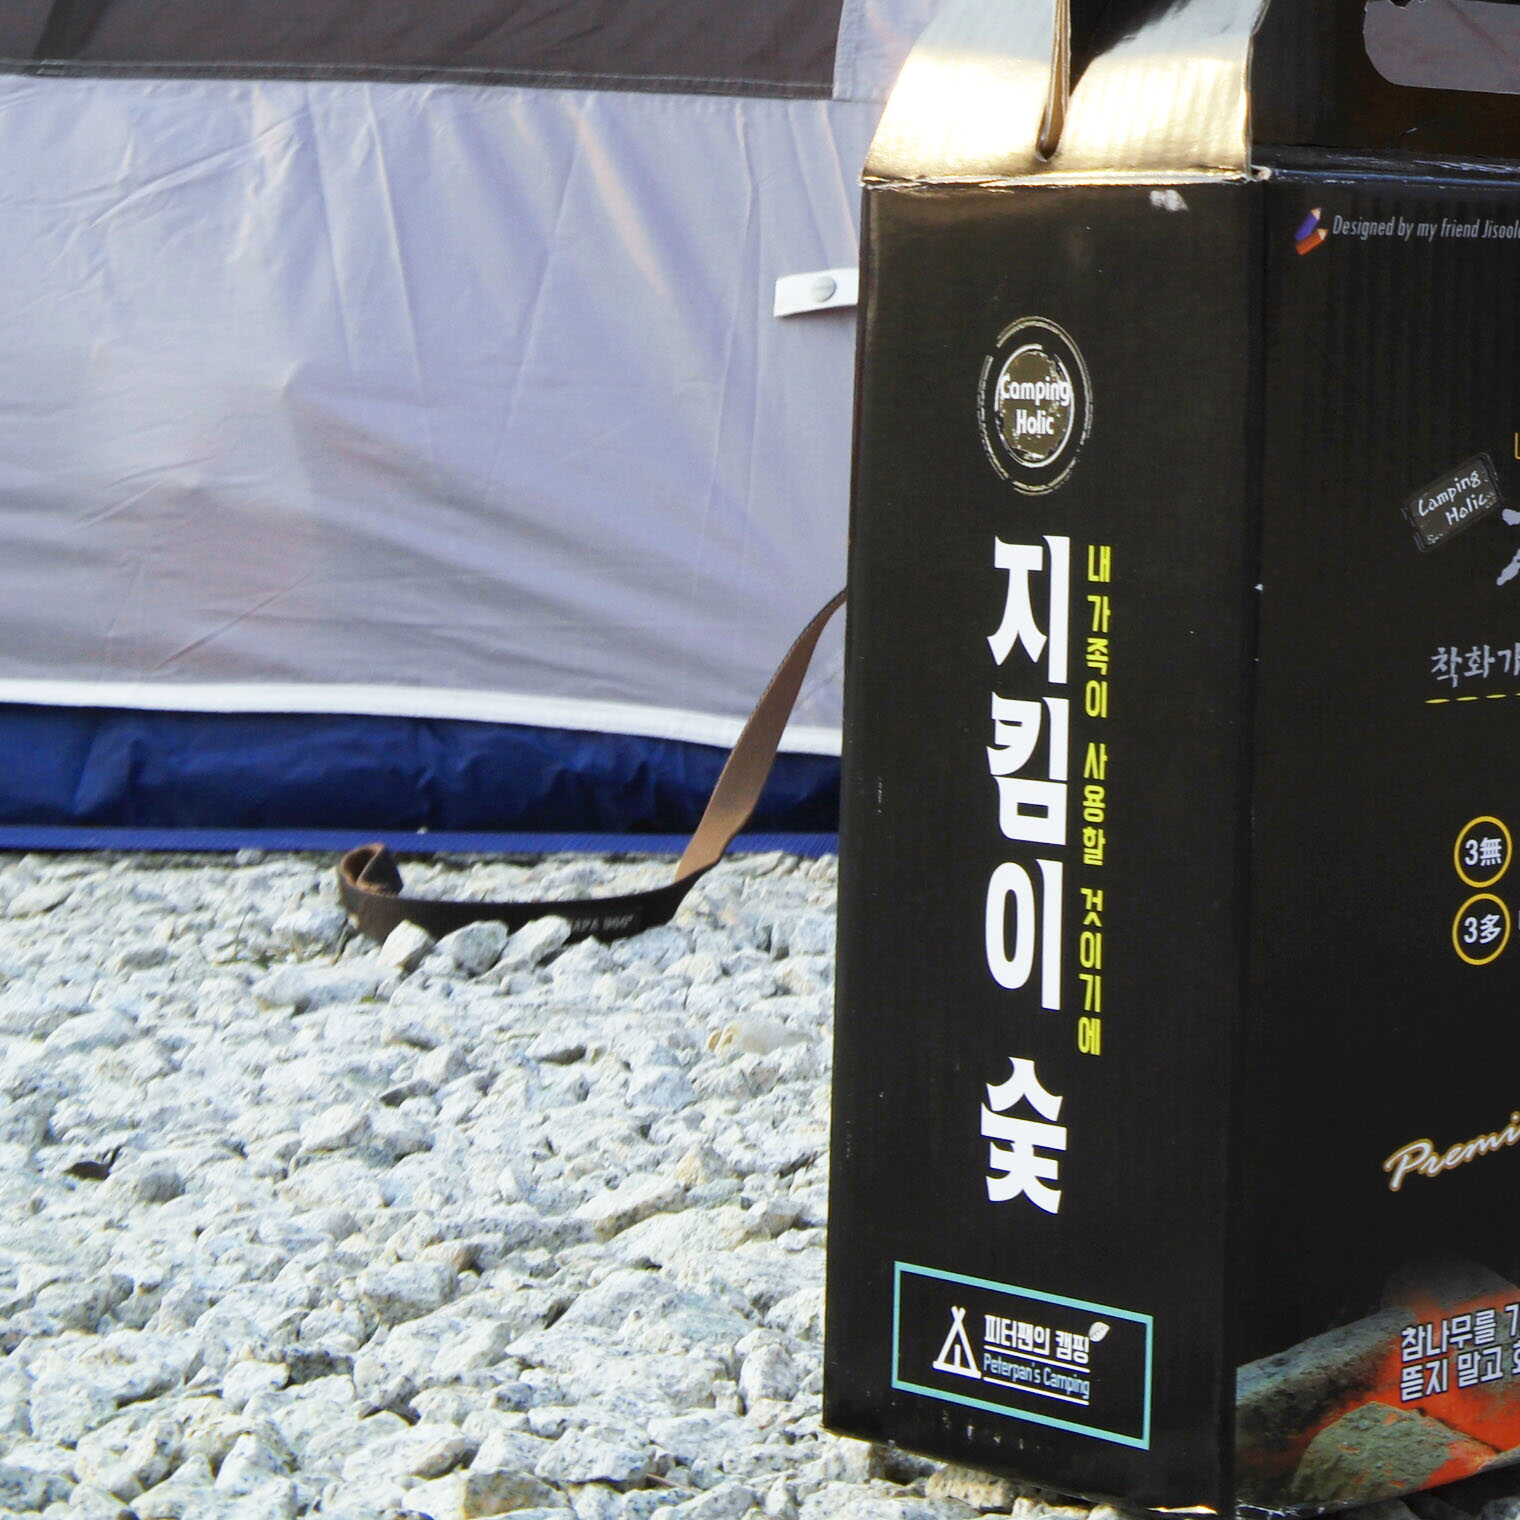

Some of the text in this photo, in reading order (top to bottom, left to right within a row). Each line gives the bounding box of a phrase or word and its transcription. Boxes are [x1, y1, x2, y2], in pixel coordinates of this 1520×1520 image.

[1332, 215, 1396, 240] Designed
[1397, 216, 1413, 241] by
[1417, 225, 1438, 242] my
[1440, 218, 1480, 238] friend
[1000, 373, 1071, 406] Camping
[1015, 409, 1055, 435] Holic
[1418, 470, 1481, 517] Camping
[1444, 493, 1488, 526] Holic
[1077, 544, 1111, 1057] 내 가족이 사용할 것이기에
[980, 534, 1070, 1215] 지킴이 숯
[984, 1314, 1090, 1365] 피터팬의 캠핑
[1401, 1309, 1497, 1363] 참나무를
[983, 1352, 1091, 1400] Peterpan's Camping
[1400, 1358, 1448, 1403] 뜯지
[1456, 1345, 1504, 1388] 말고
